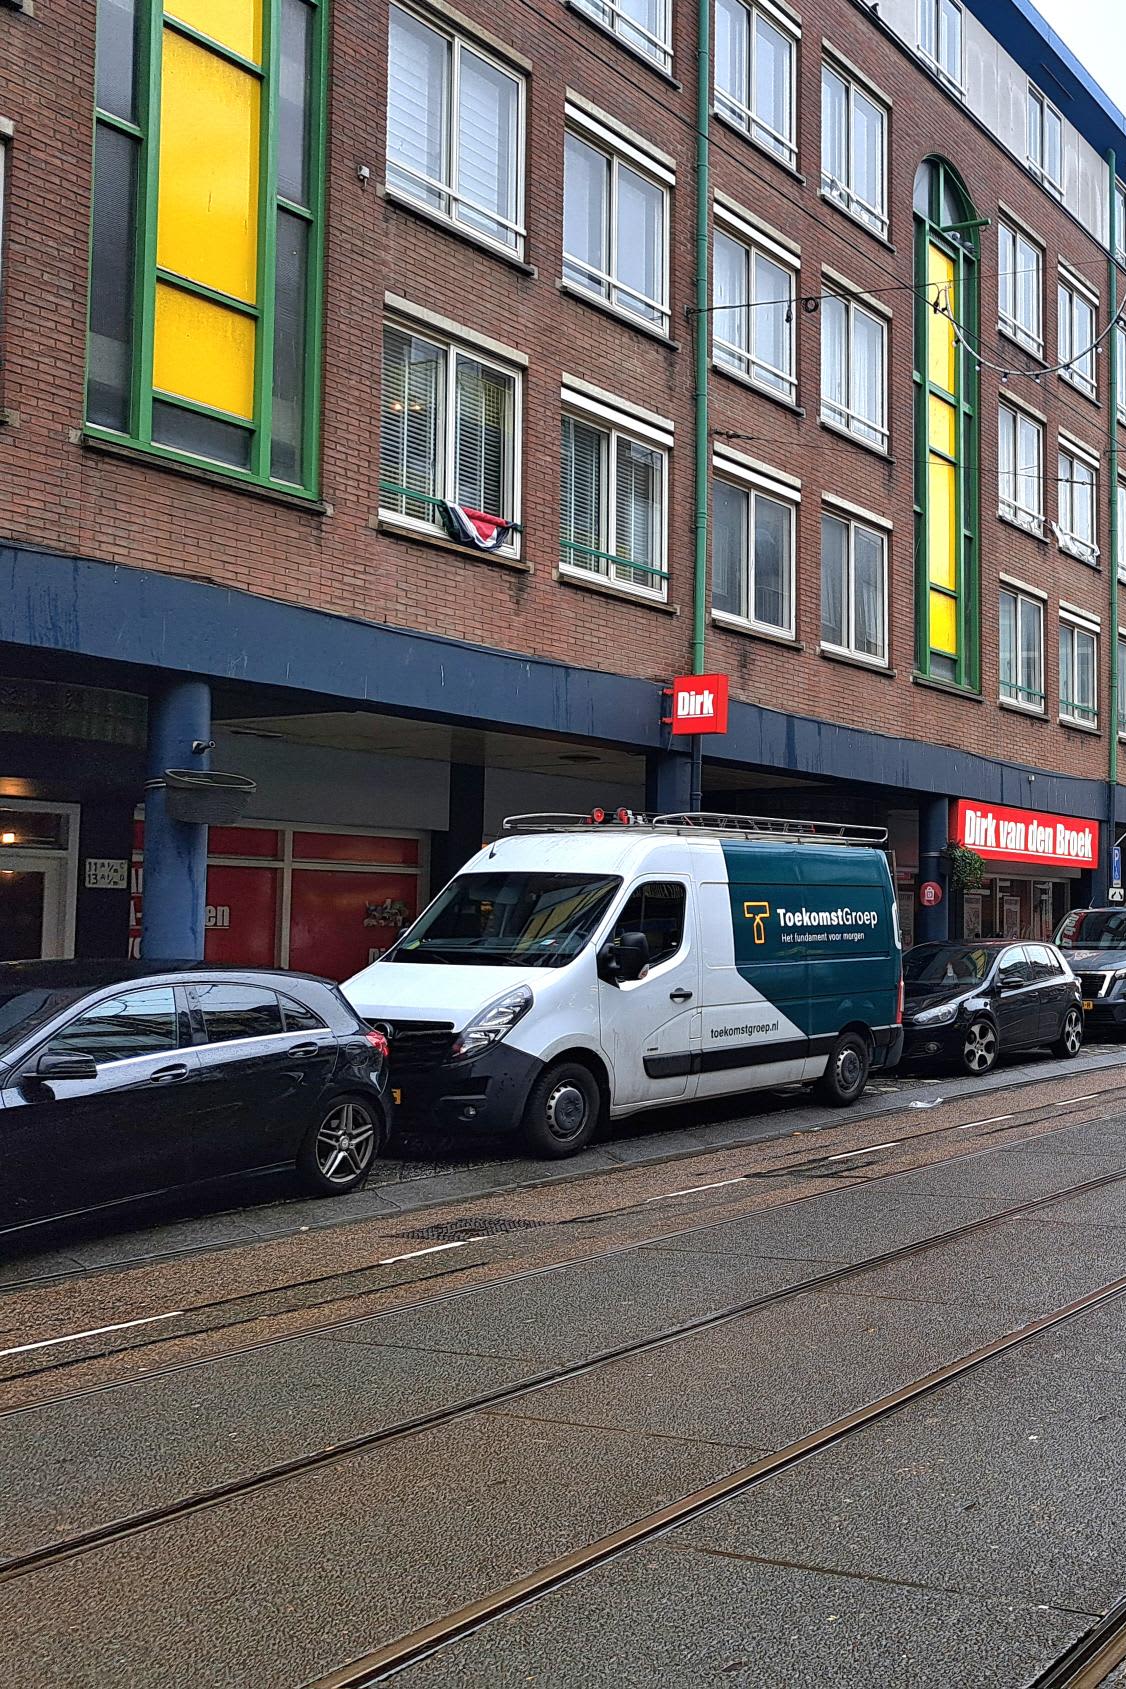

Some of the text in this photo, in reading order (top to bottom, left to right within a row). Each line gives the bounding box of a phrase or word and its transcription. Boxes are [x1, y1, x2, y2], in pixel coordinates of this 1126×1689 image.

[677, 690, 714, 715] Dirk
[965, 809, 1092, 858] Dirk van den Broek
[88, 861, 98, 873] 11
[88, 873, 98, 885] 13
[777, 907, 878, 928] ToekomstGroep
[781, 932, 865, 943] Het fundament voor morgen
[710, 1019, 779, 1039] toekomstgroep.nl
